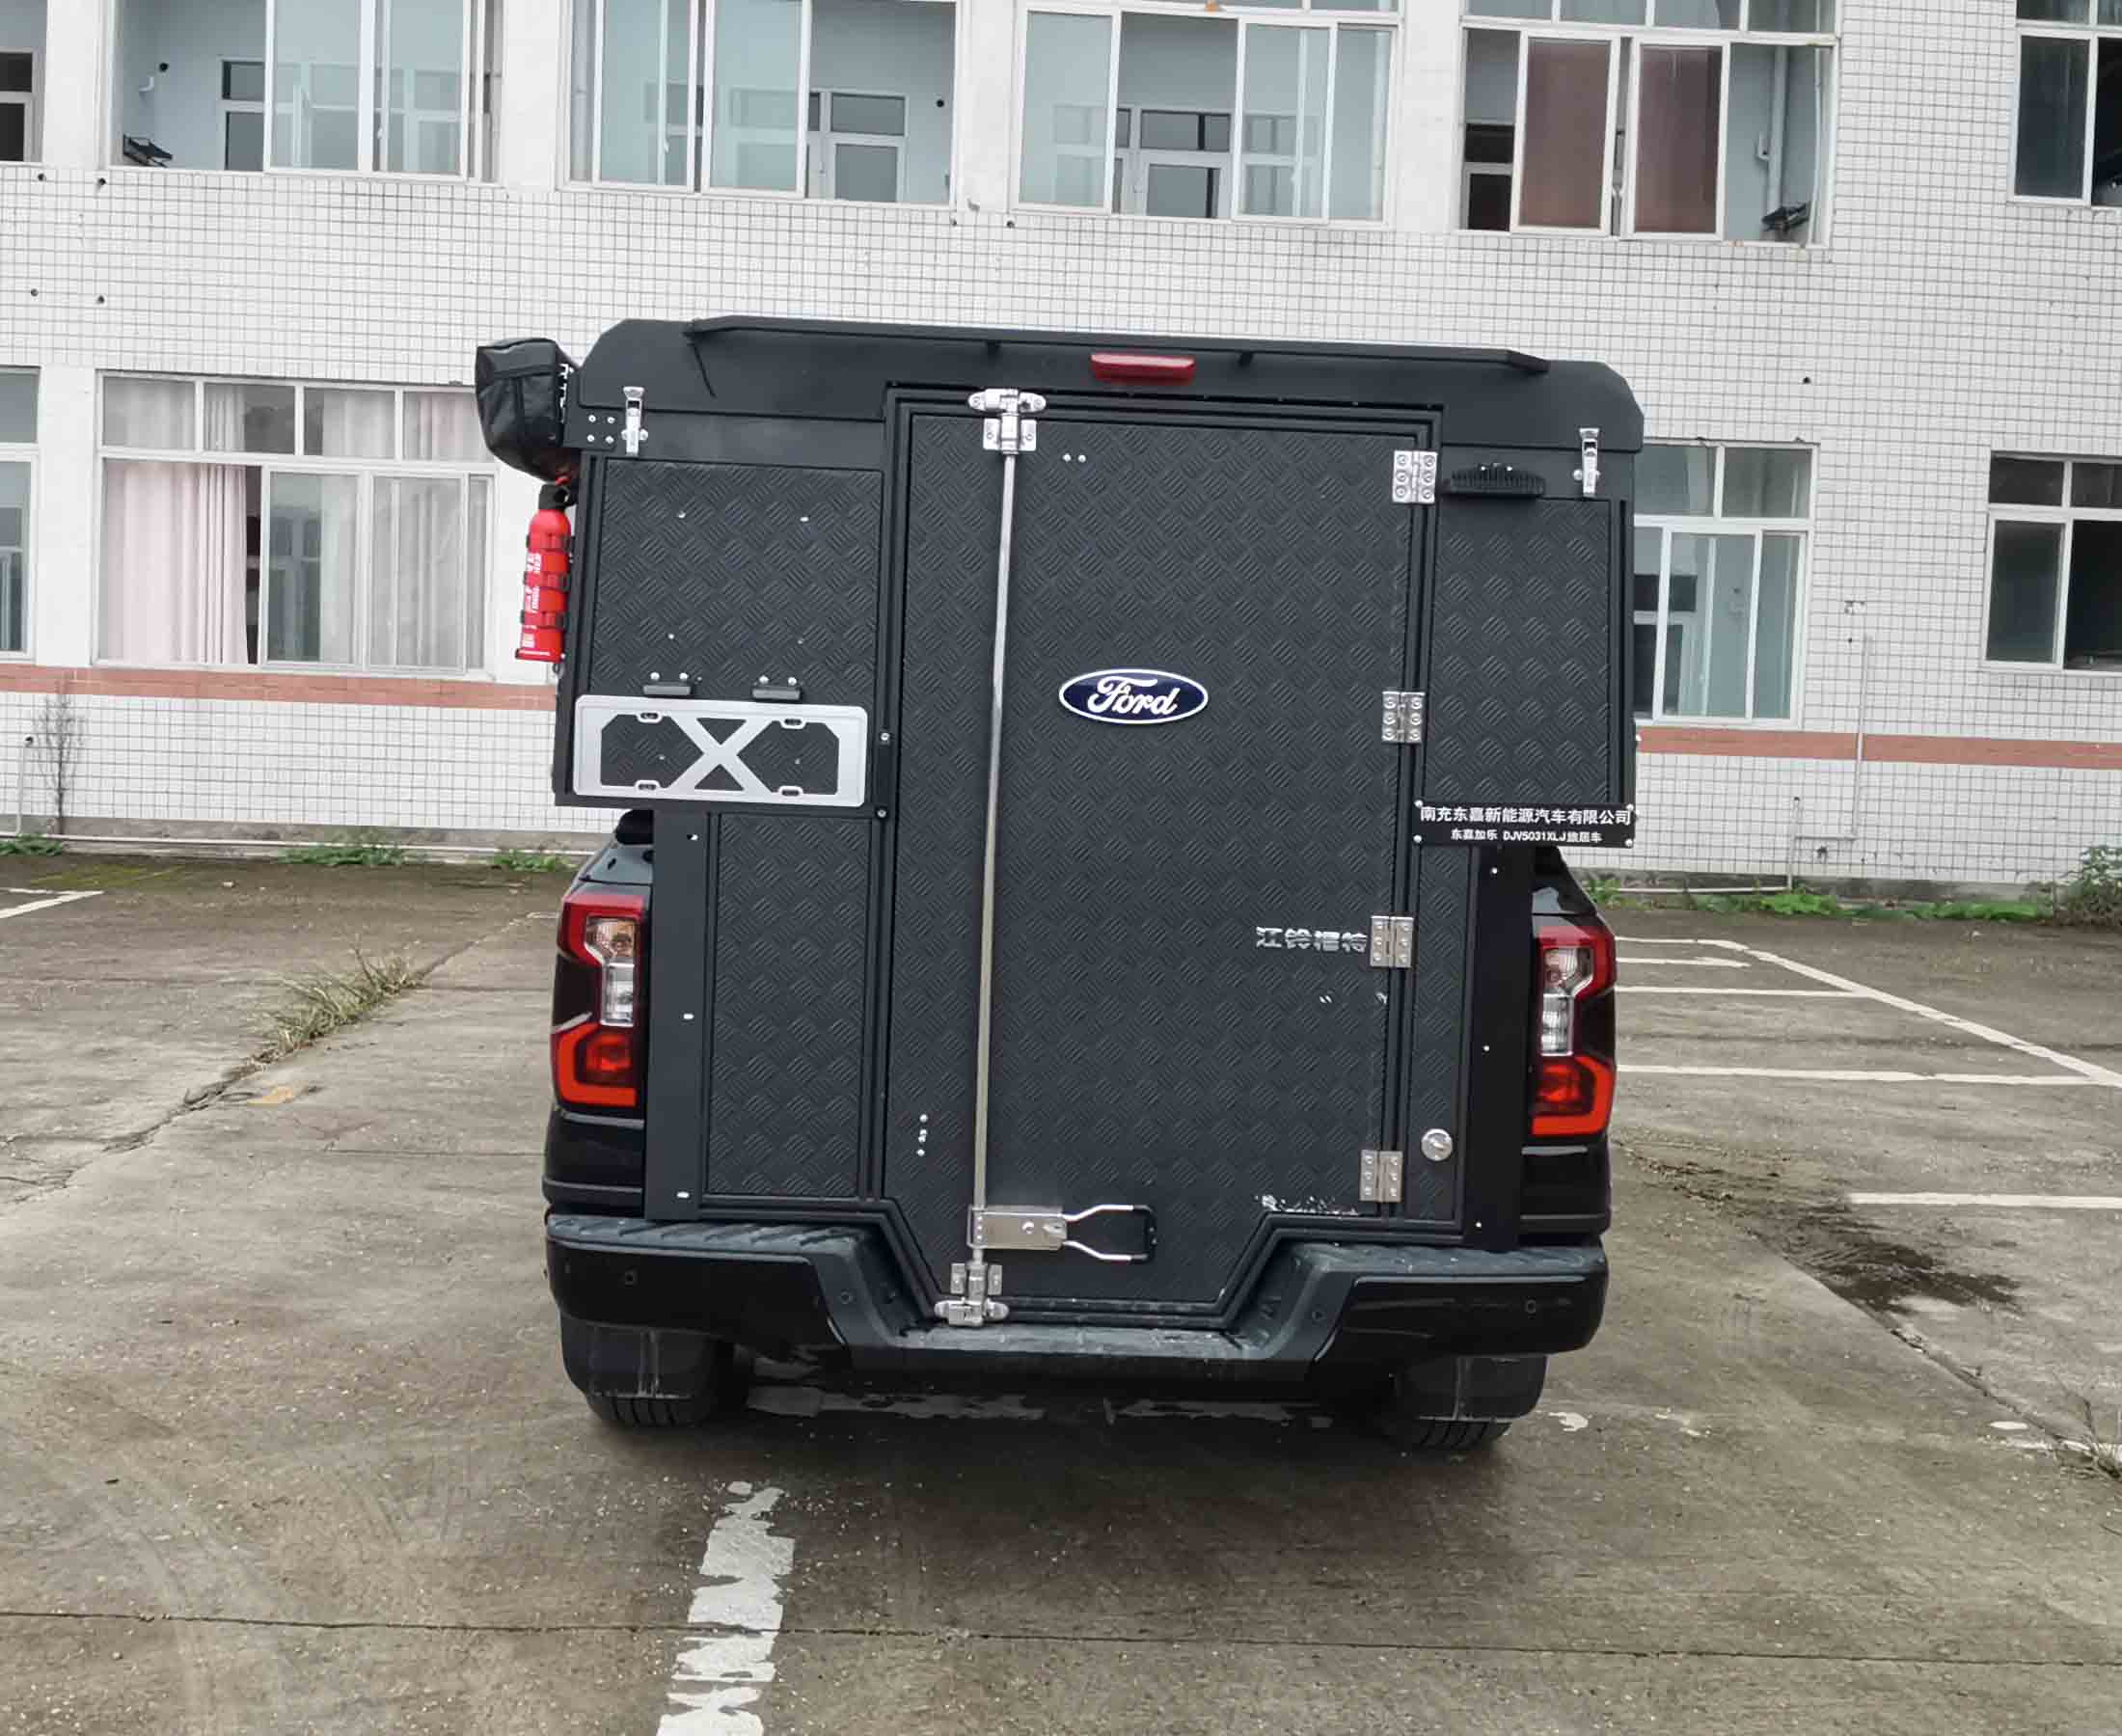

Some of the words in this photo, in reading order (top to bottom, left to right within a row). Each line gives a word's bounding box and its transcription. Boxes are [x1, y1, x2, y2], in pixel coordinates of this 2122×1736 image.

[1087, 676, 1181, 715] Ford
[1256, 926, 1368, 953] 江铃福特
